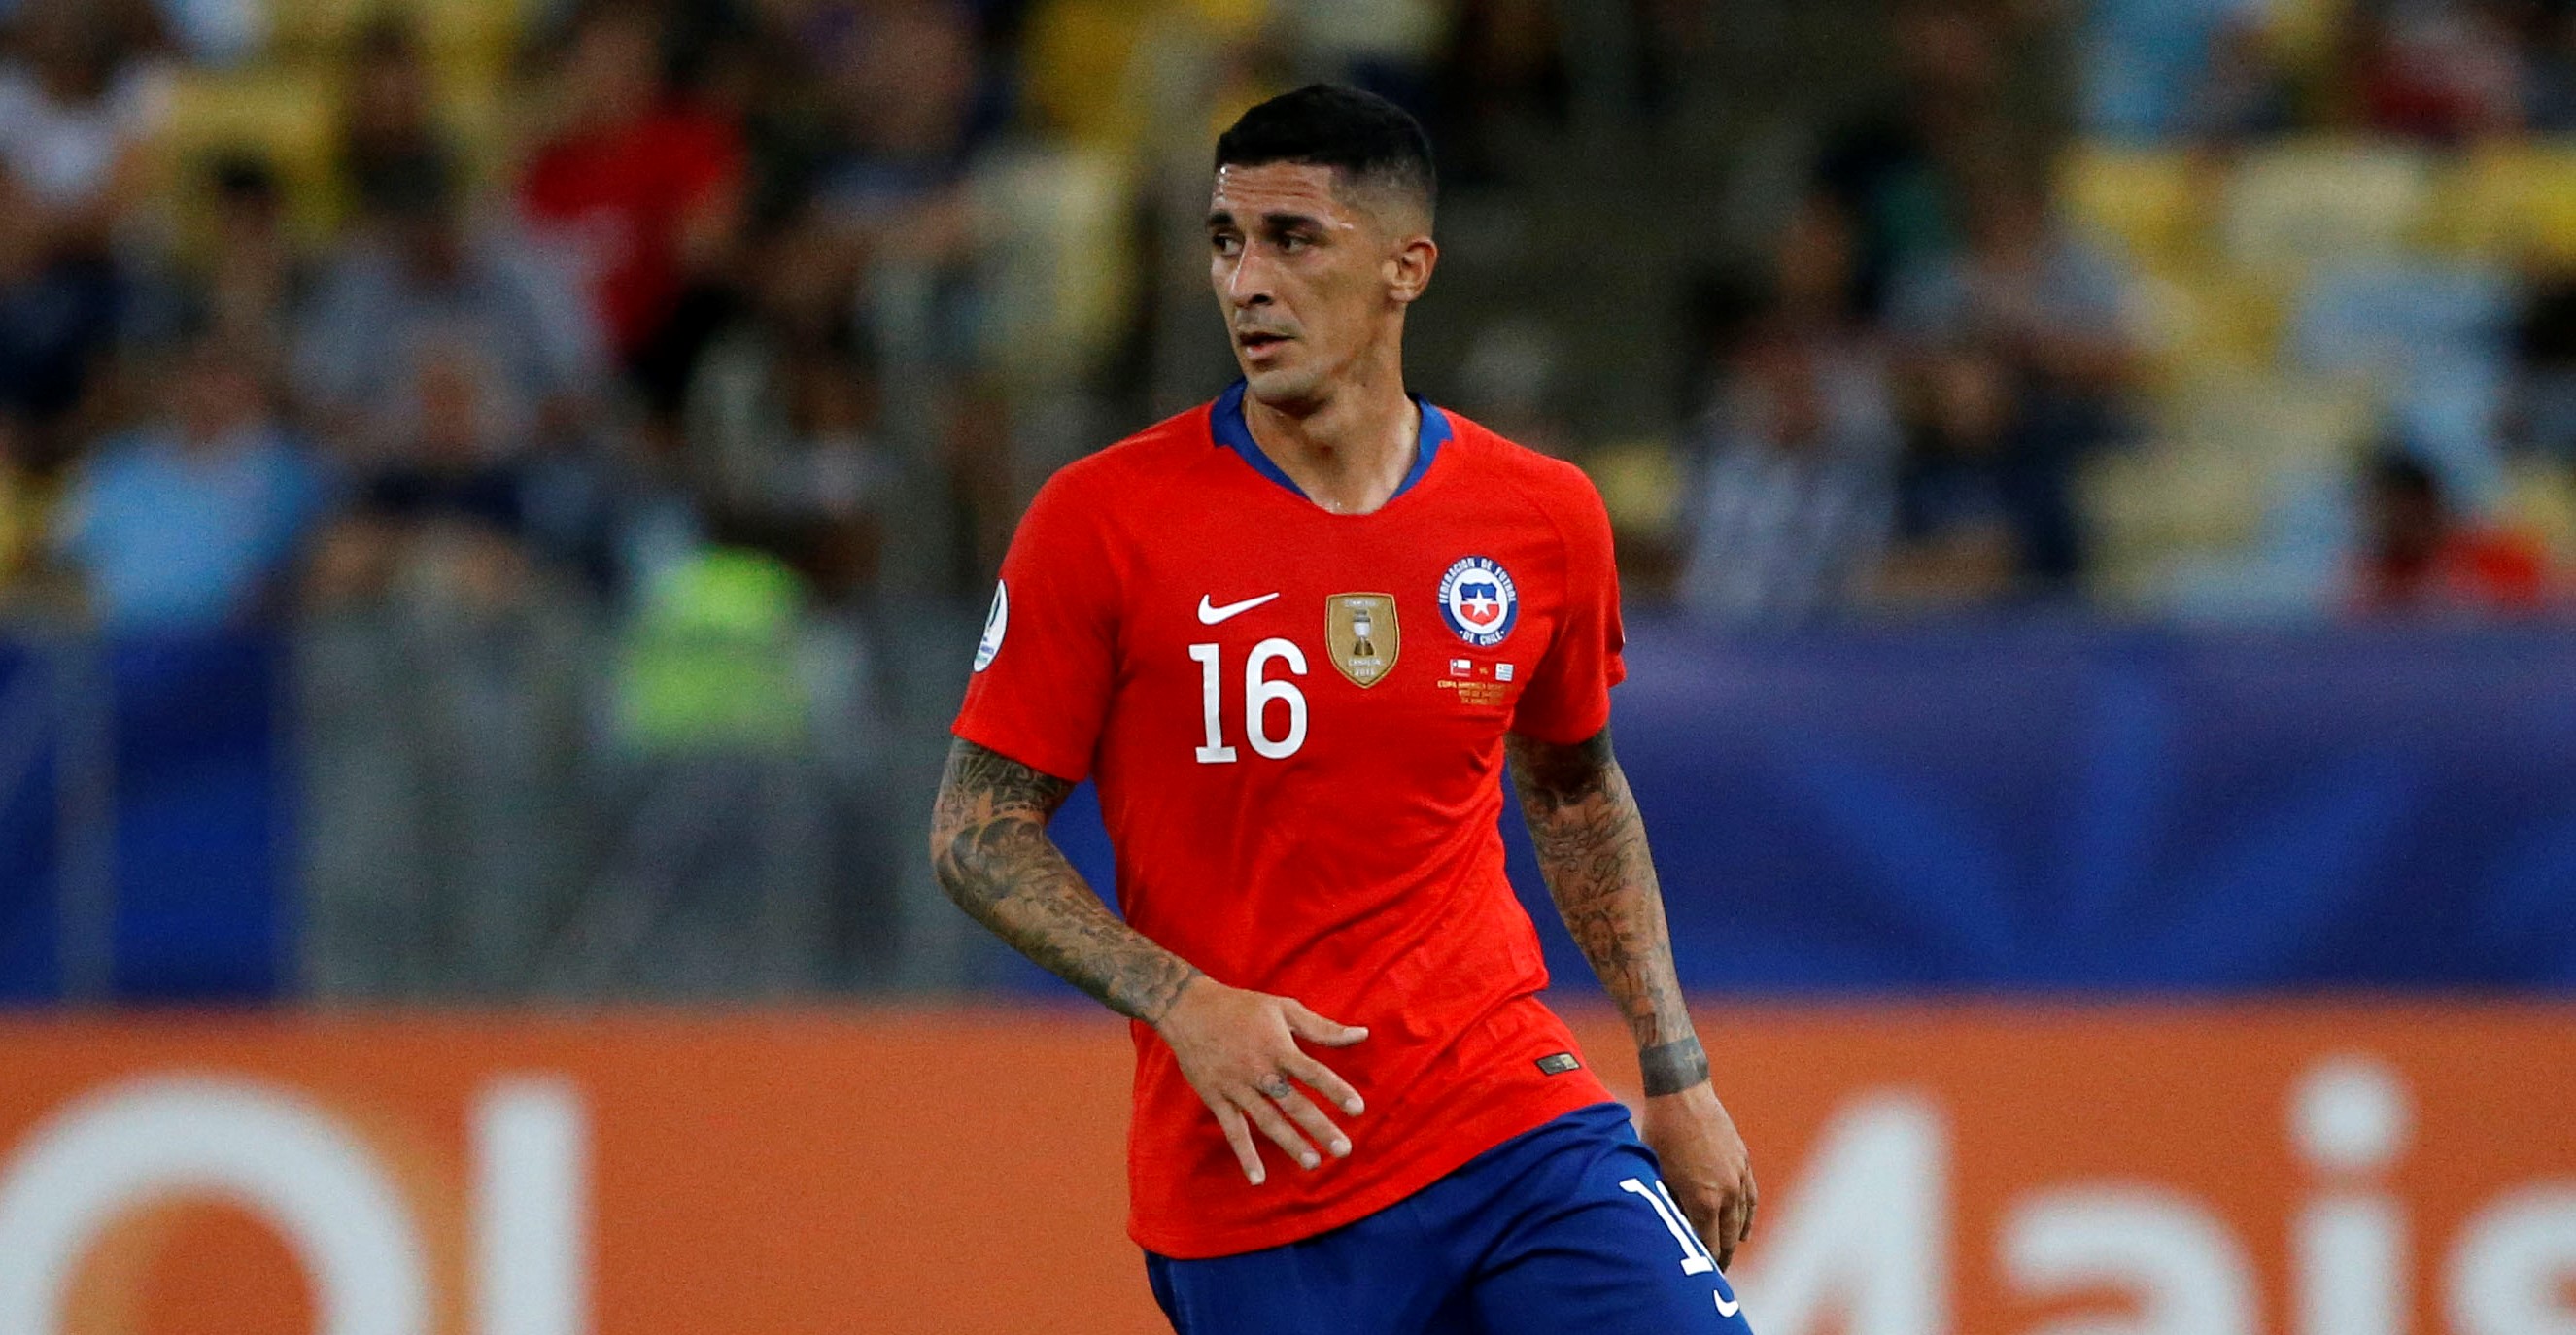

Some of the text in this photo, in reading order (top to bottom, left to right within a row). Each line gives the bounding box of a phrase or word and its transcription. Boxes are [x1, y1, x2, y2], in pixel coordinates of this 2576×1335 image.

[1481, 557, 1493, 570] DE
[1462, 631, 1503, 646] DE CHILE
[1188, 637, 1308, 764] 16
[1619, 1178, 1726, 1279] 1
